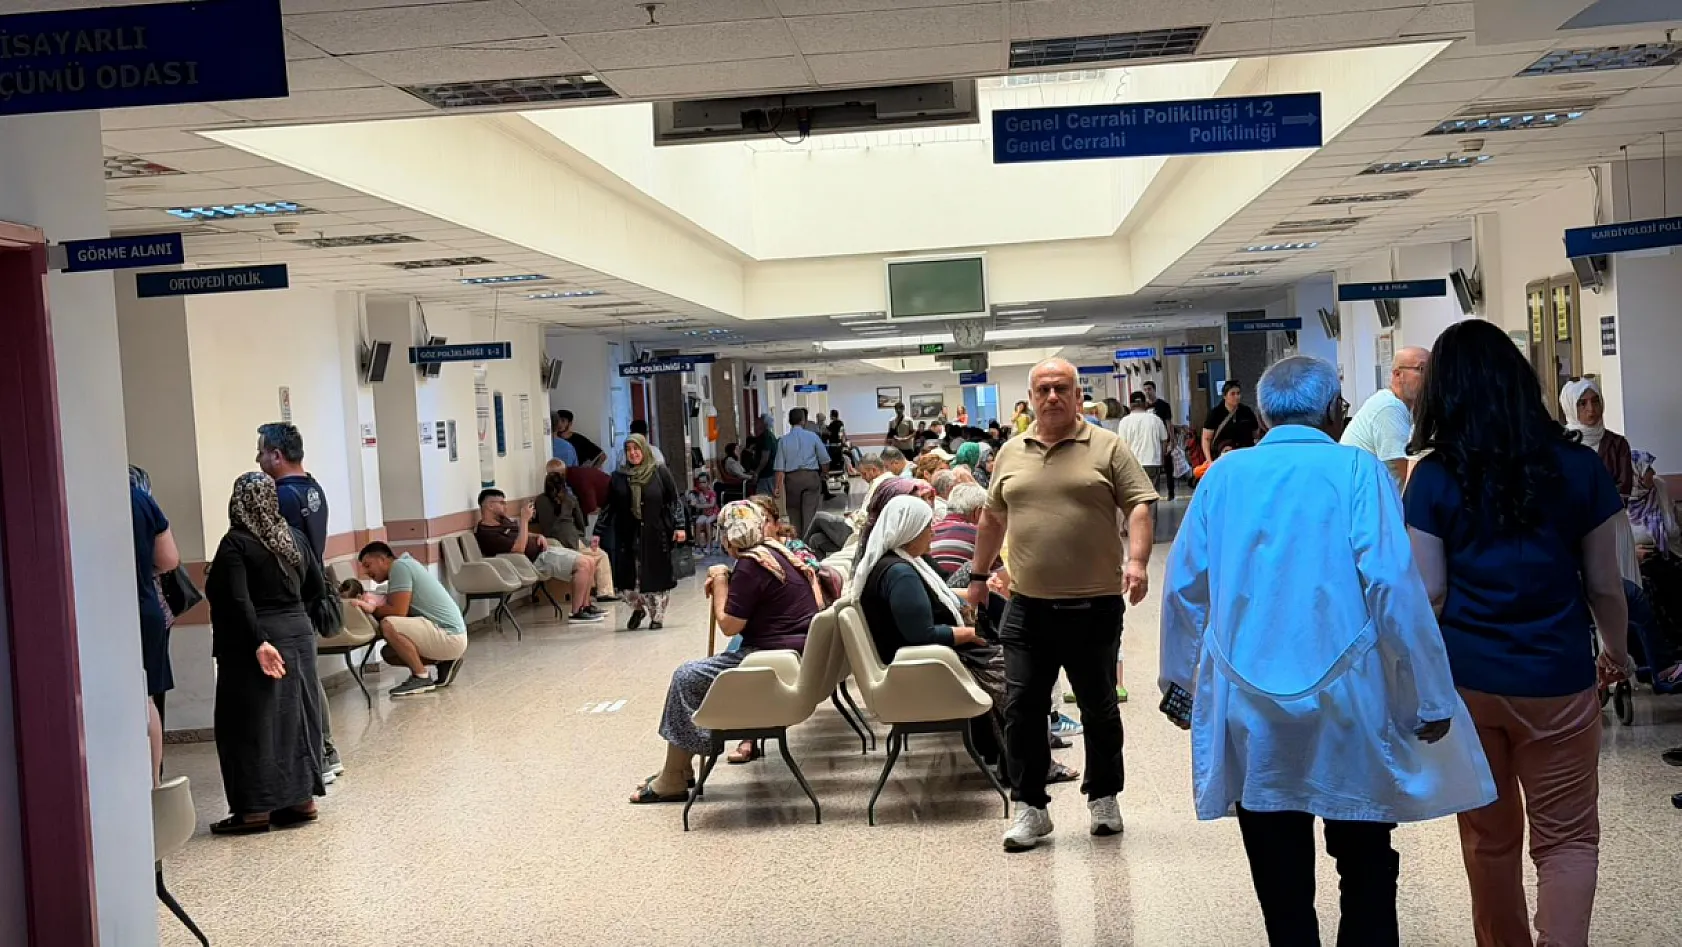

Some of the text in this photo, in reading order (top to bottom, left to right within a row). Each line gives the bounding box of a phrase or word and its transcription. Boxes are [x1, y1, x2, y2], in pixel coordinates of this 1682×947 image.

[0, 26, 147, 58] İSAYARLI
[0, 61, 199, 100] ÇÜMÜ ODASI
[1005, 101, 1274, 132] Genel Cerrahi Polikliniği 1-2
[1006, 123, 1277, 153] Genel Cerrahi Polikliniği
[1591, 219, 1682, 240] KARDİYOLOJİ POLİ
[77, 242, 173, 262] GÖRME ALANI
[169, 270, 264, 291] ORTOPEDİ POLİK.
[420, 350, 435, 358] GÖZ
[623, 366, 639, 374] GÖZ
